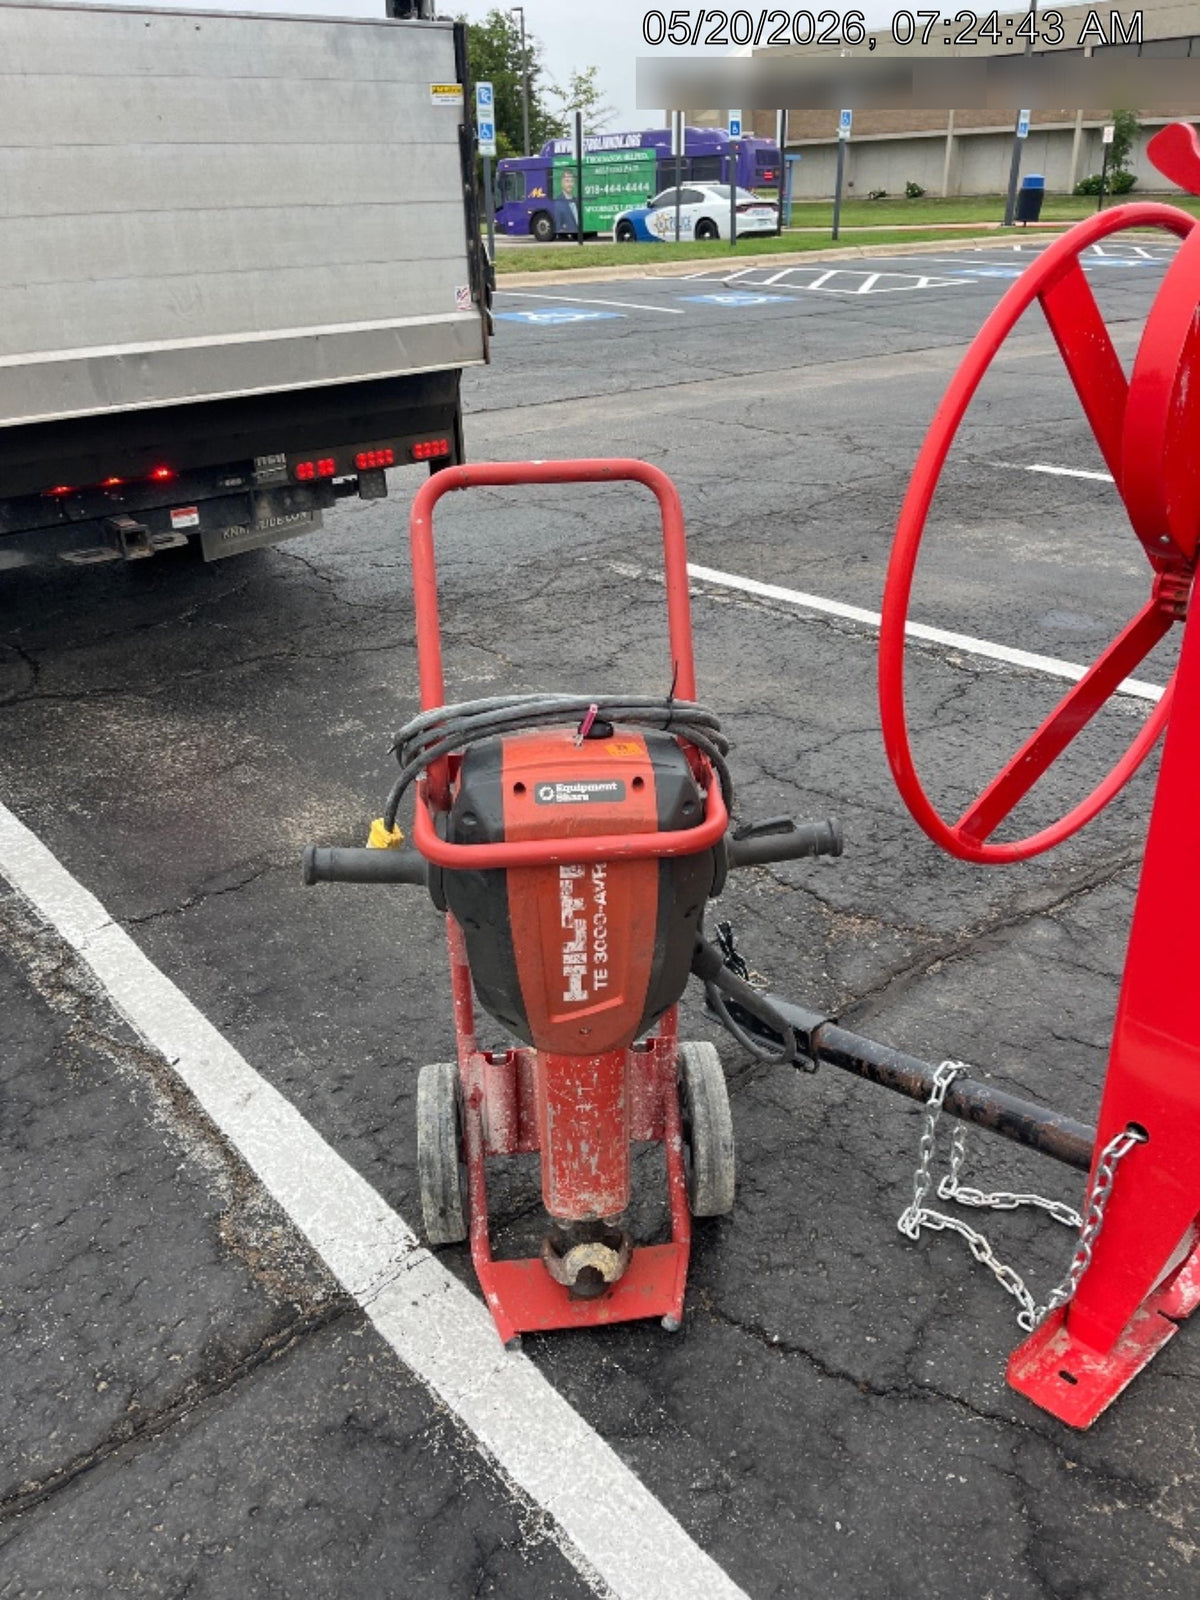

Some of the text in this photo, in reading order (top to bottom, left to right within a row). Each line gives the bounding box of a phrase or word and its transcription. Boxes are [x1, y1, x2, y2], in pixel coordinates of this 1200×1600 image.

[556, 782, 618, 793] Equipment
[556, 793, 590, 802] Share
[559, 863, 588, 1002] HILTI
[593, 968, 608, 991] TE
